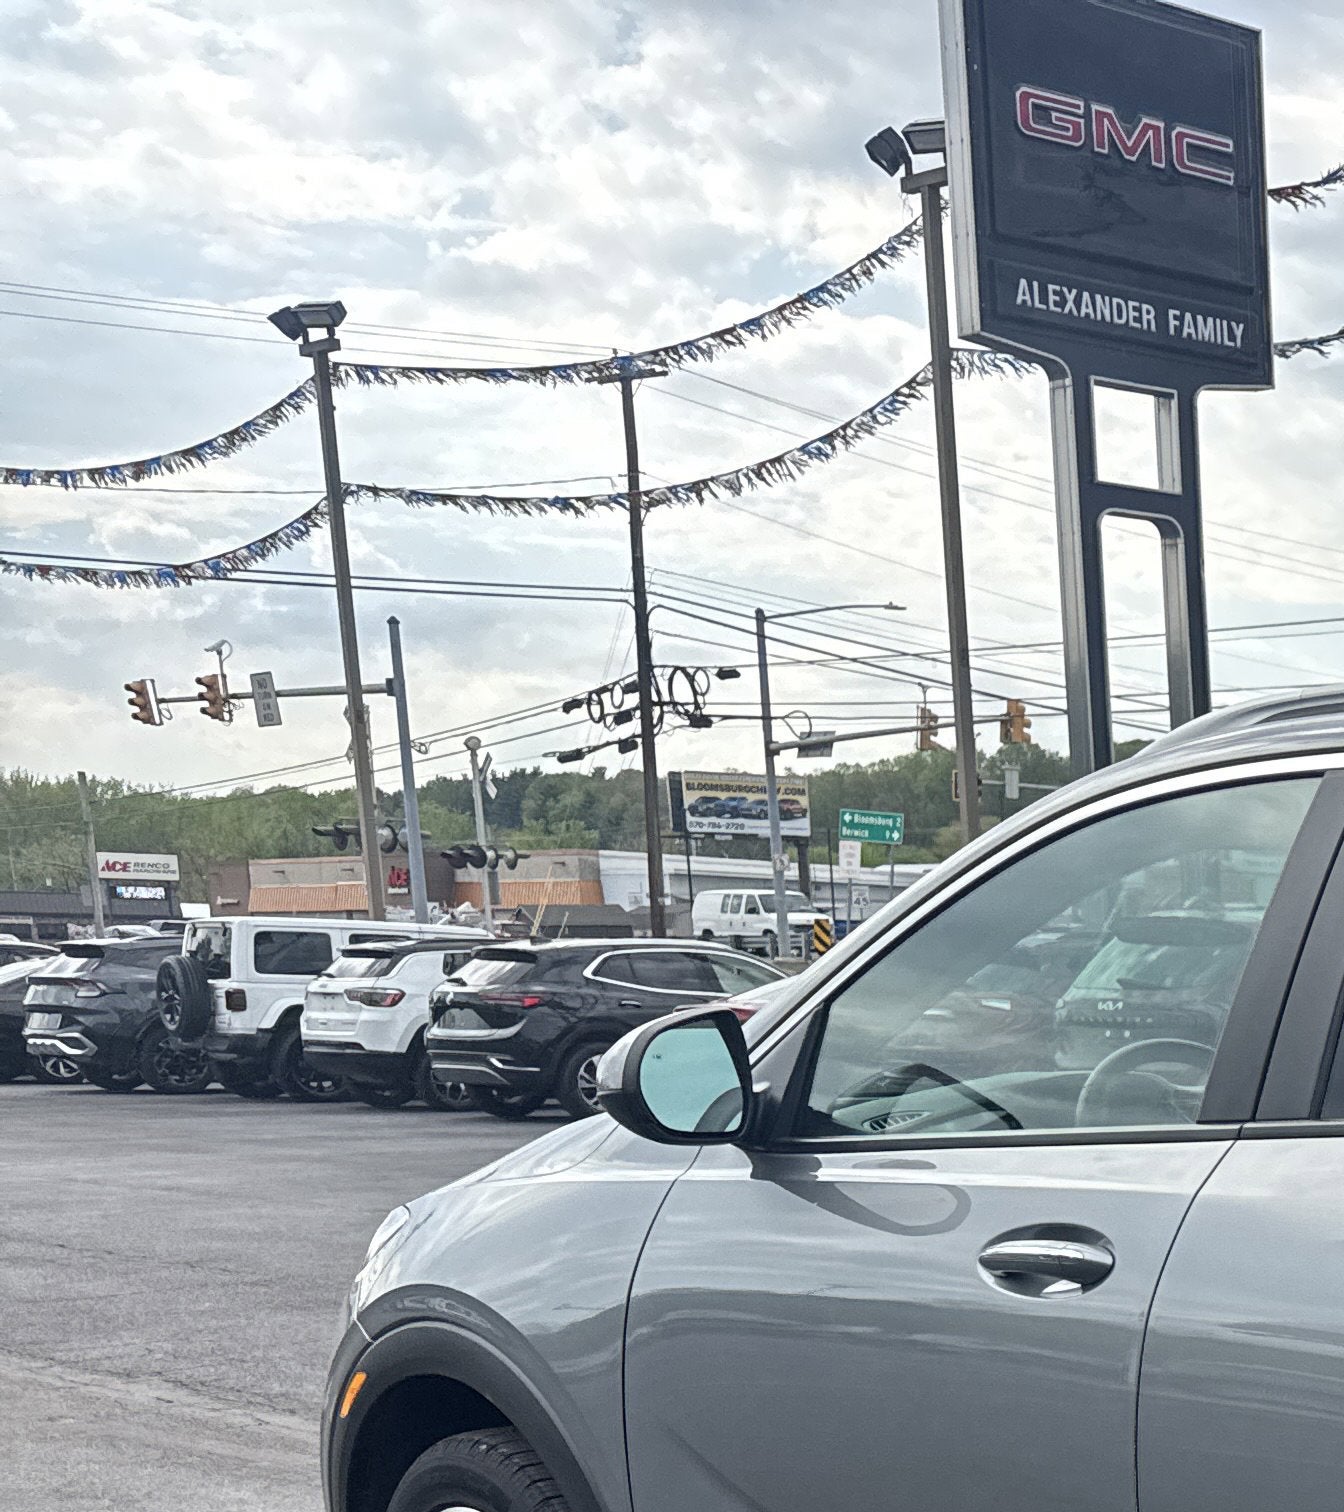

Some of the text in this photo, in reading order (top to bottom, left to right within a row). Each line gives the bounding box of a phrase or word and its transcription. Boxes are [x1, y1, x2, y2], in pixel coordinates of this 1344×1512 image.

[1015, 84, 1234, 186] GMC
[1015, 278, 1245, 348] ALEXANDER FAMILY
[100, 859, 132, 873] ACE
